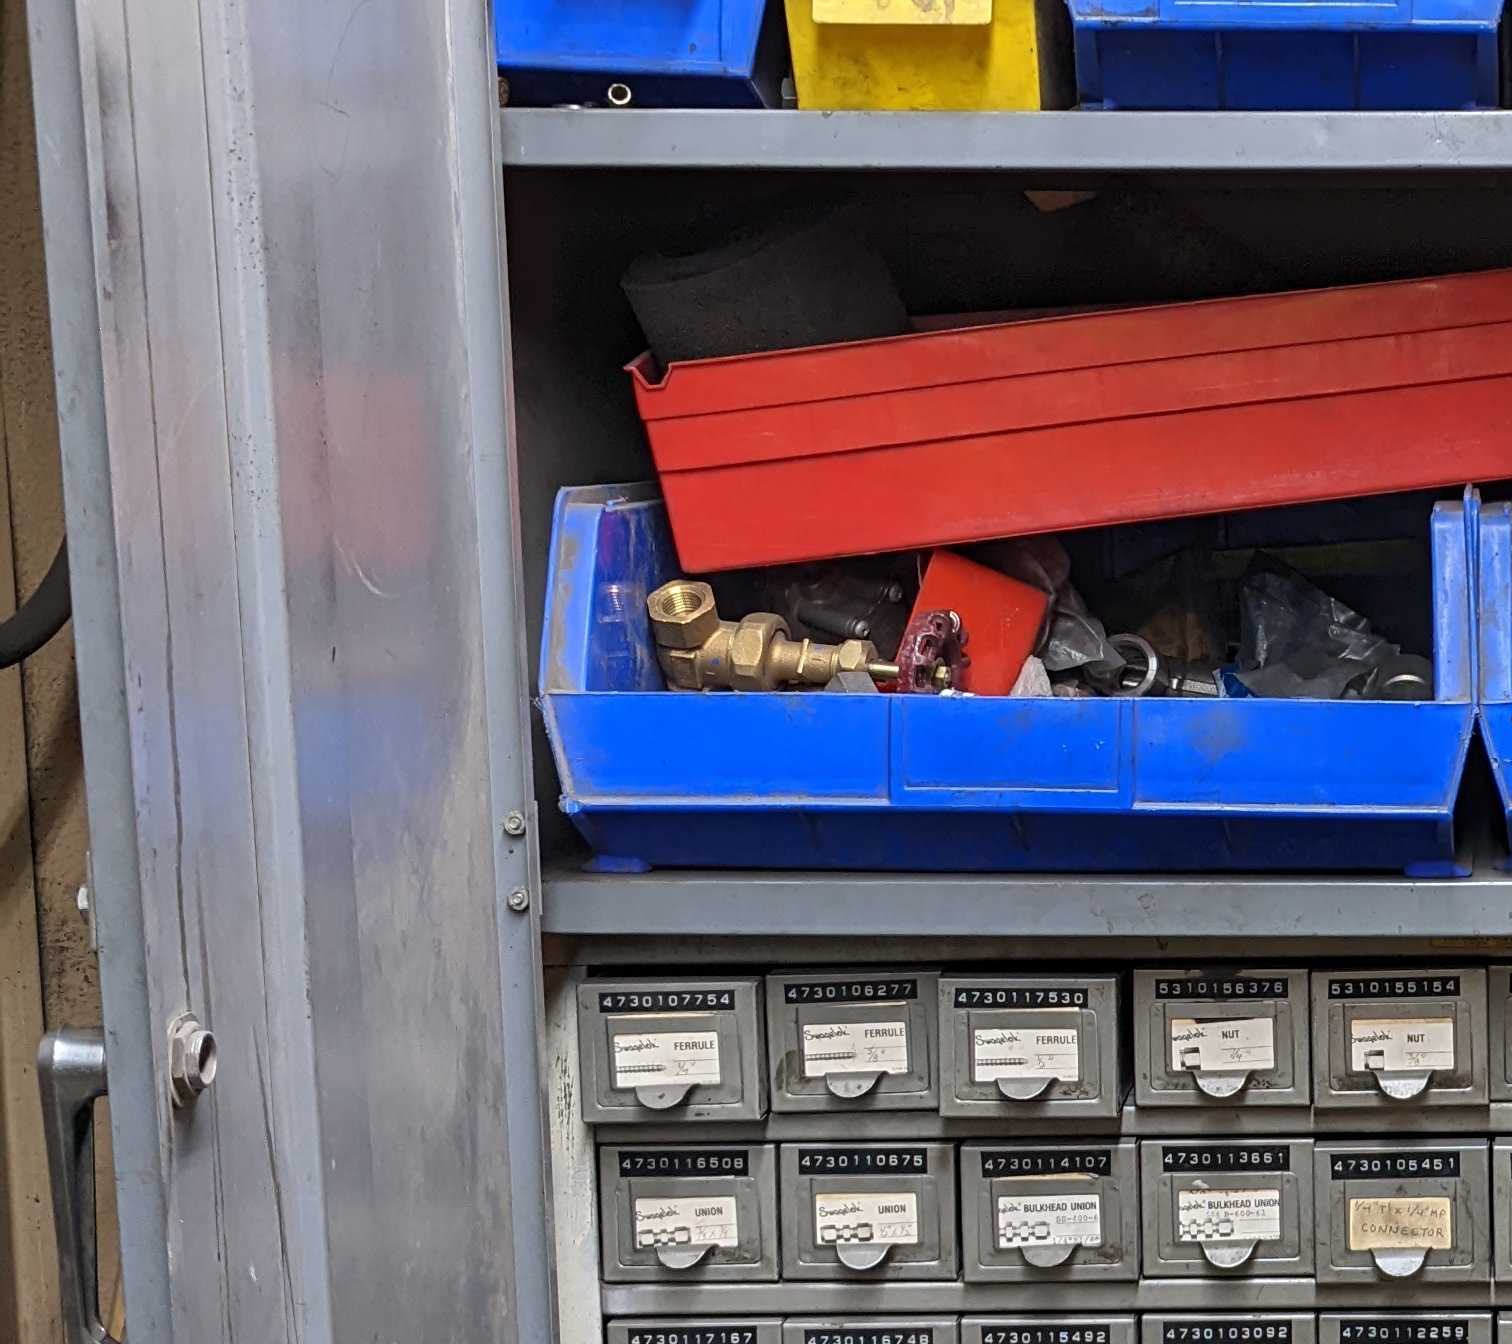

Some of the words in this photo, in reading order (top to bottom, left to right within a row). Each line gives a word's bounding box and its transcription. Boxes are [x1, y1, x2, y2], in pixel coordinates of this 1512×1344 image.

[788, 983, 913, 1000] 4730106277
[1331, 980, 1455, 994] 5310155154
[603, 994, 730, 1008] 4730107754
[958, 990, 1083, 1004] 4730117530
[864, 1028, 905, 1038] FERRULE
[1037, 1035, 1077, 1044] FERRULE
[1222, 1030, 1239, 1039] NUT
[1407, 1034, 1424, 1043] NUT
[674, 1041, 715, 1050] FERRULE
[622, 1156, 744, 1169] 4730116508
[801, 1154, 923, 1167] 4730110675
[985, 1157, 1107, 1171] 4730114107
[1164, 1151, 1284, 1166] 4730113661
[1334, 1158, 1455, 1172] 4730105451
[878, 1204, 906, 1214] UNION
[1023, 1202, 1067, 1213] BULKHEAD
[1070, 1201, 1096, 1211] UNION
[1207, 1199, 1251, 1209] BULKHEAD
[695, 1206, 723, 1217] UNION
[984, 1333, 1107, 1344] 4730115492
[1166, 1326, 1289, 1340] 4730103092
[1342, 1326, 1465, 1339] 4730112259
